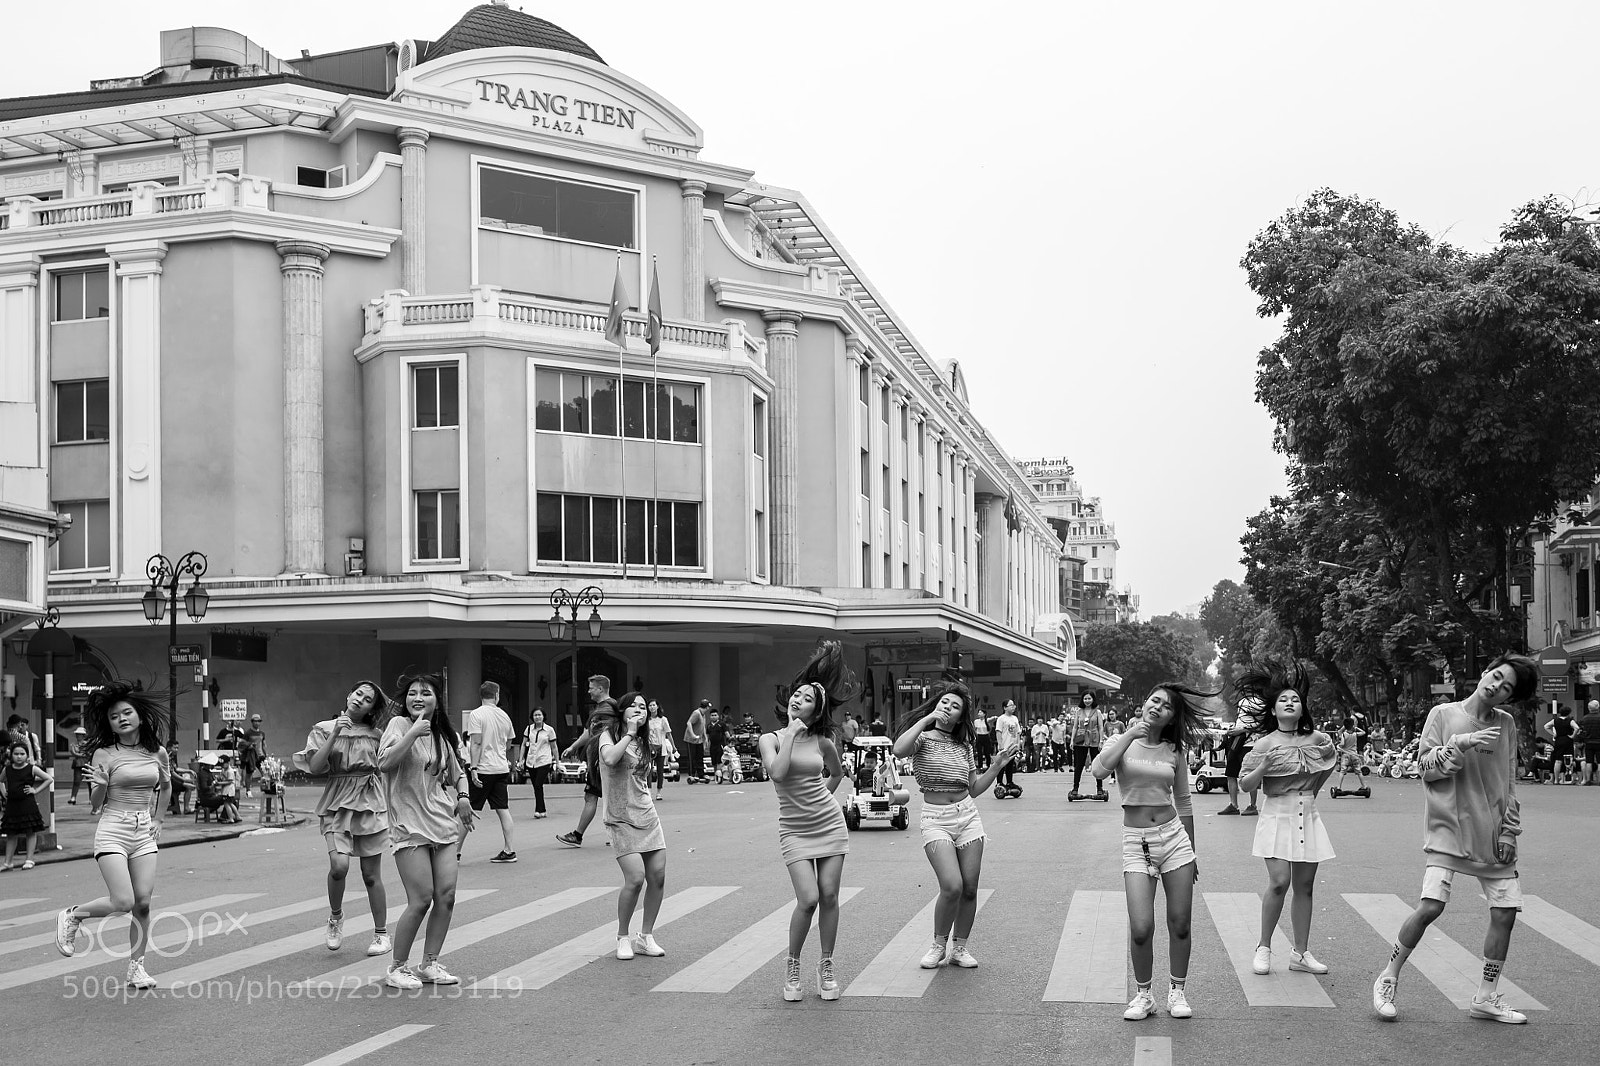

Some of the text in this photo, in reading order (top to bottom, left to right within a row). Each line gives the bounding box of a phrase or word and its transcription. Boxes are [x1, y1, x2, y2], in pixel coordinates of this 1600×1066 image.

[475, 79, 637, 130] TRANG TIEN
[532, 115, 585, 136] PLAZA
